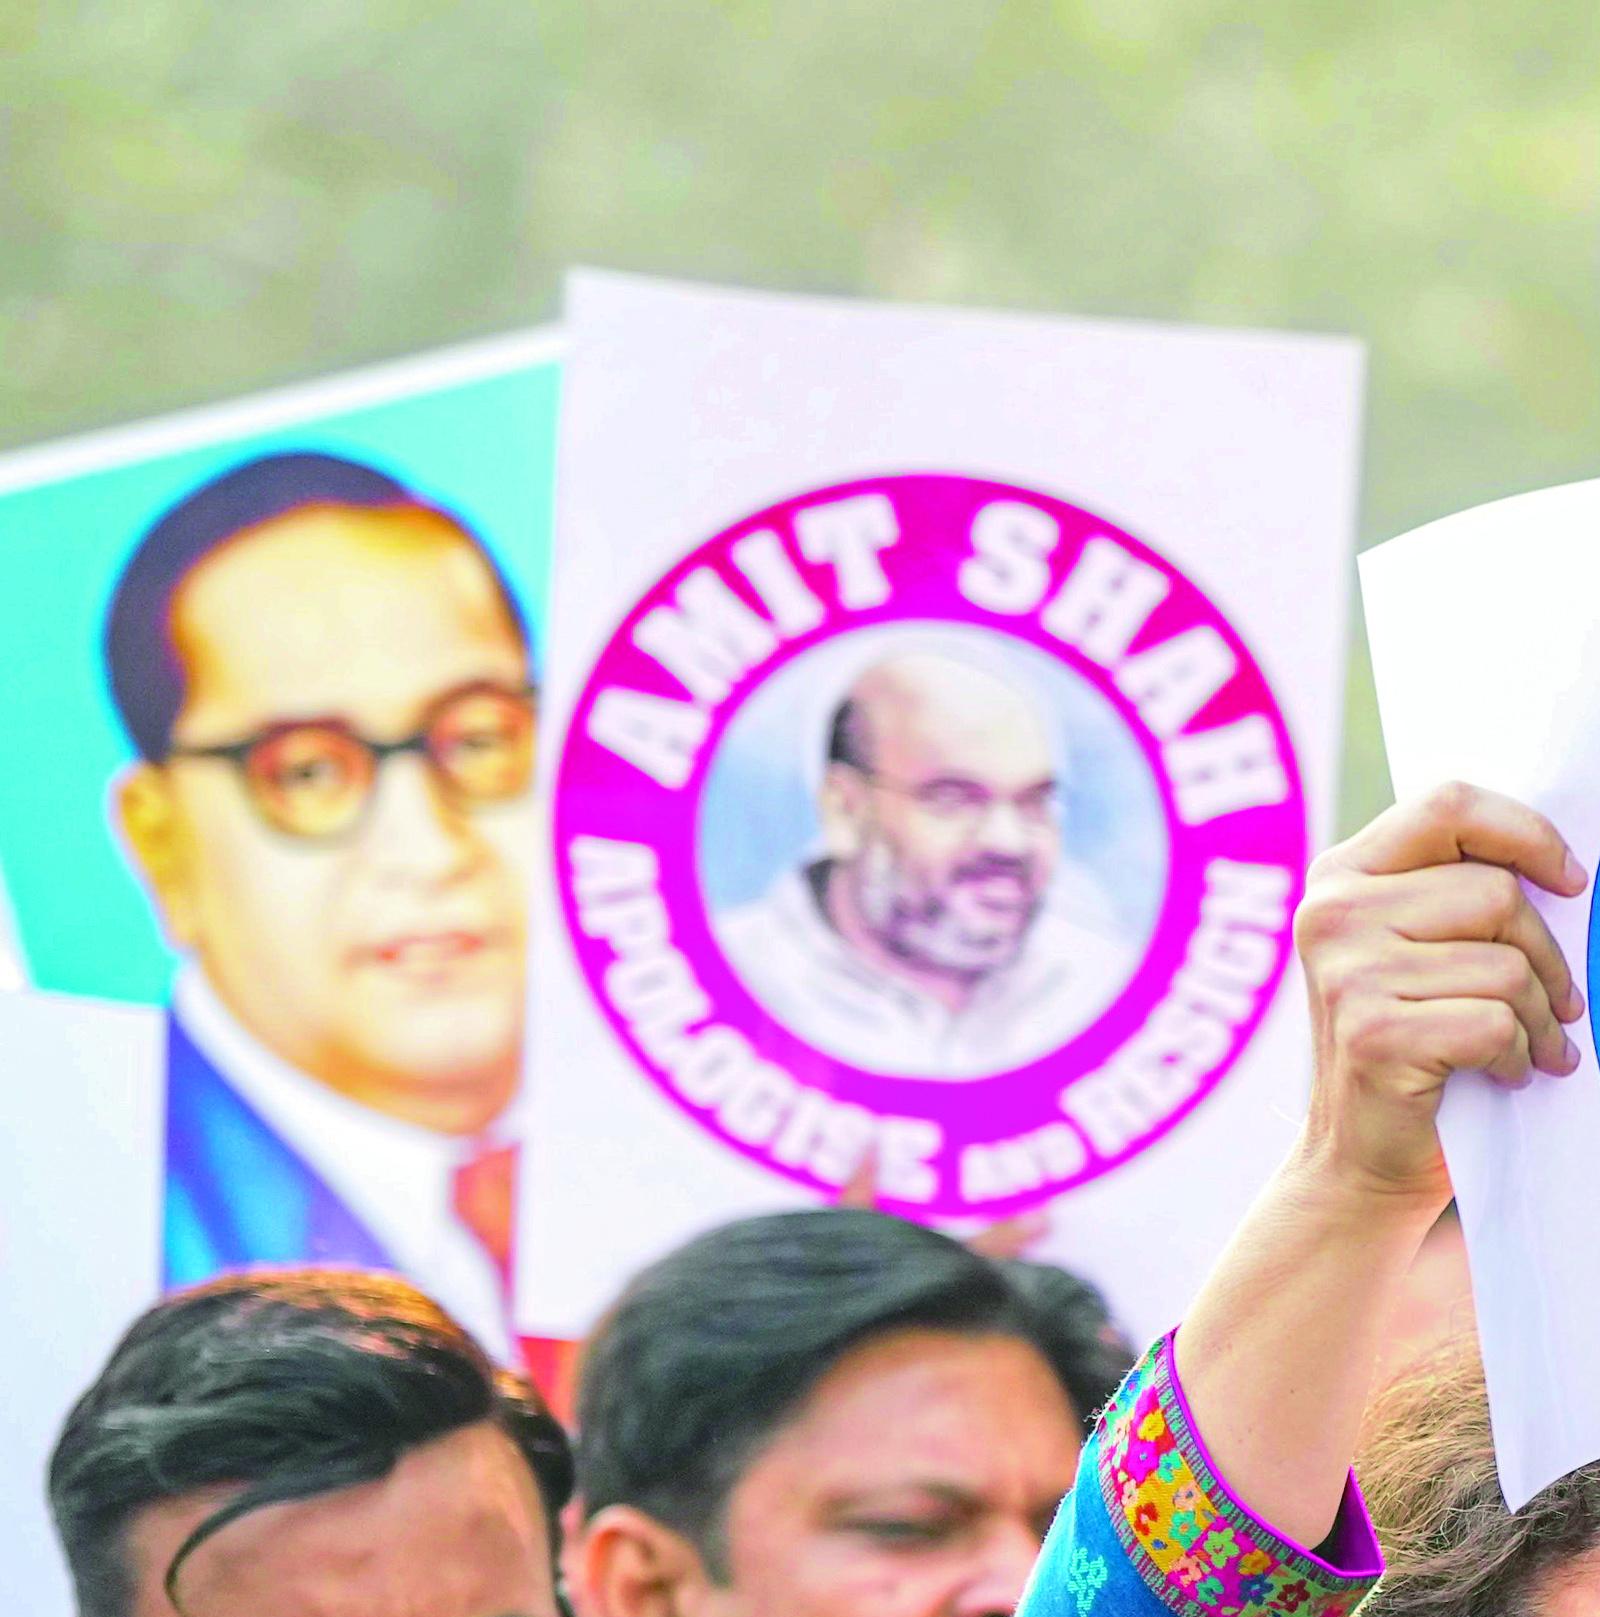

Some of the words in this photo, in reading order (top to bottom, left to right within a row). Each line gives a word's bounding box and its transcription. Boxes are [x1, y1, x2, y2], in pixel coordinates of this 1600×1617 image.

[586, 492, 901, 790] AMIT
[957, 499, 1290, 826] SHAH
[567, 834, 943, 1203] APOLOGISE
[957, 1121, 1087, 1203] AND
[1058, 857, 1293, 1159] RESIGN
